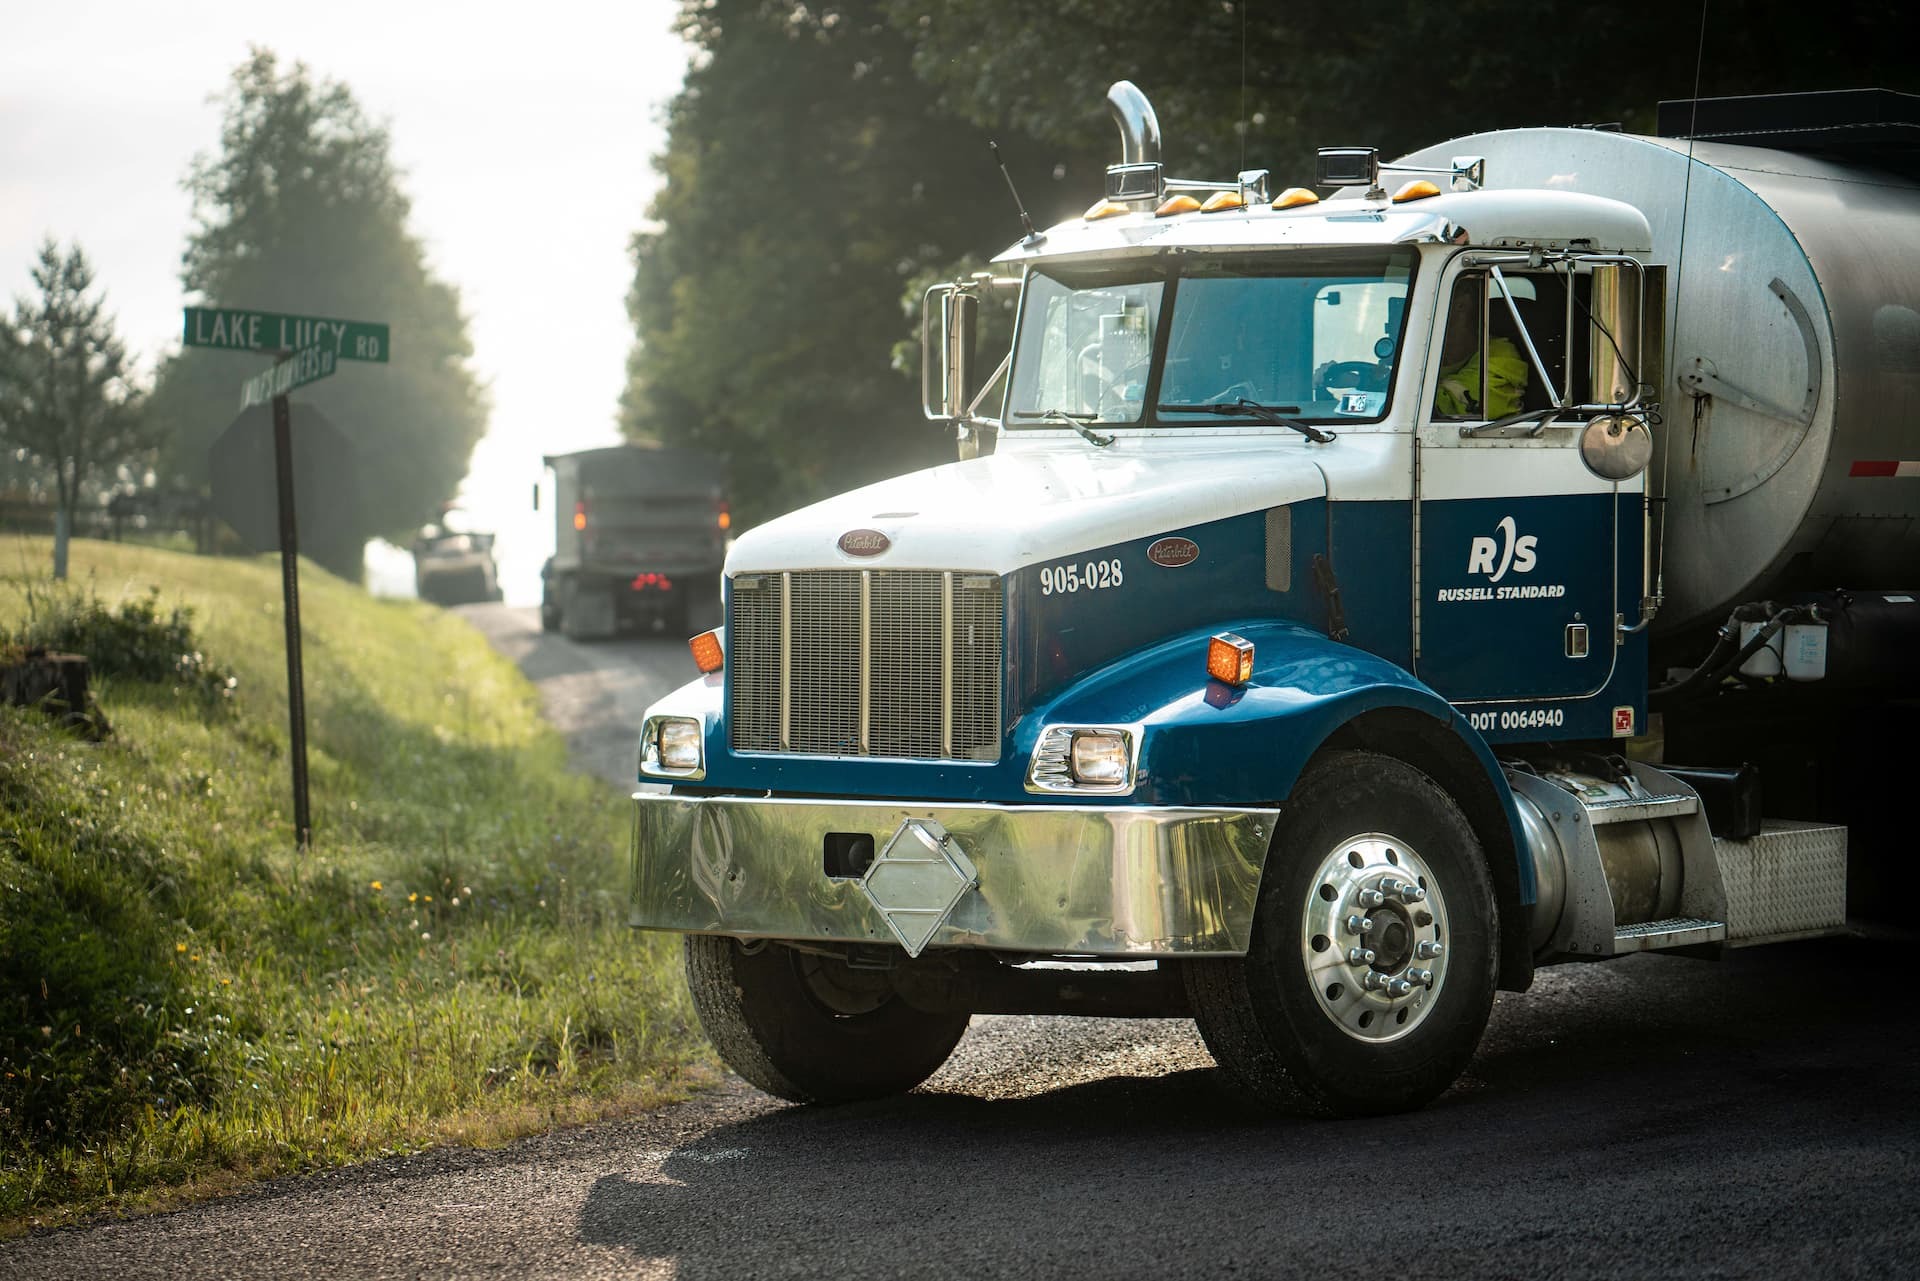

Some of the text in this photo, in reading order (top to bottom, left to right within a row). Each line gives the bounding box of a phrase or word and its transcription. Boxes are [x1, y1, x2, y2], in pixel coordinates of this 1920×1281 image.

[195, 311, 263, 348] LAKE
[356, 335, 379, 358] RD
[1040, 559, 1123, 596] 905-028
[1437, 585, 1565, 602] RUSSELL STANDARD
[1470, 708, 1564, 731] DOT 0064940
